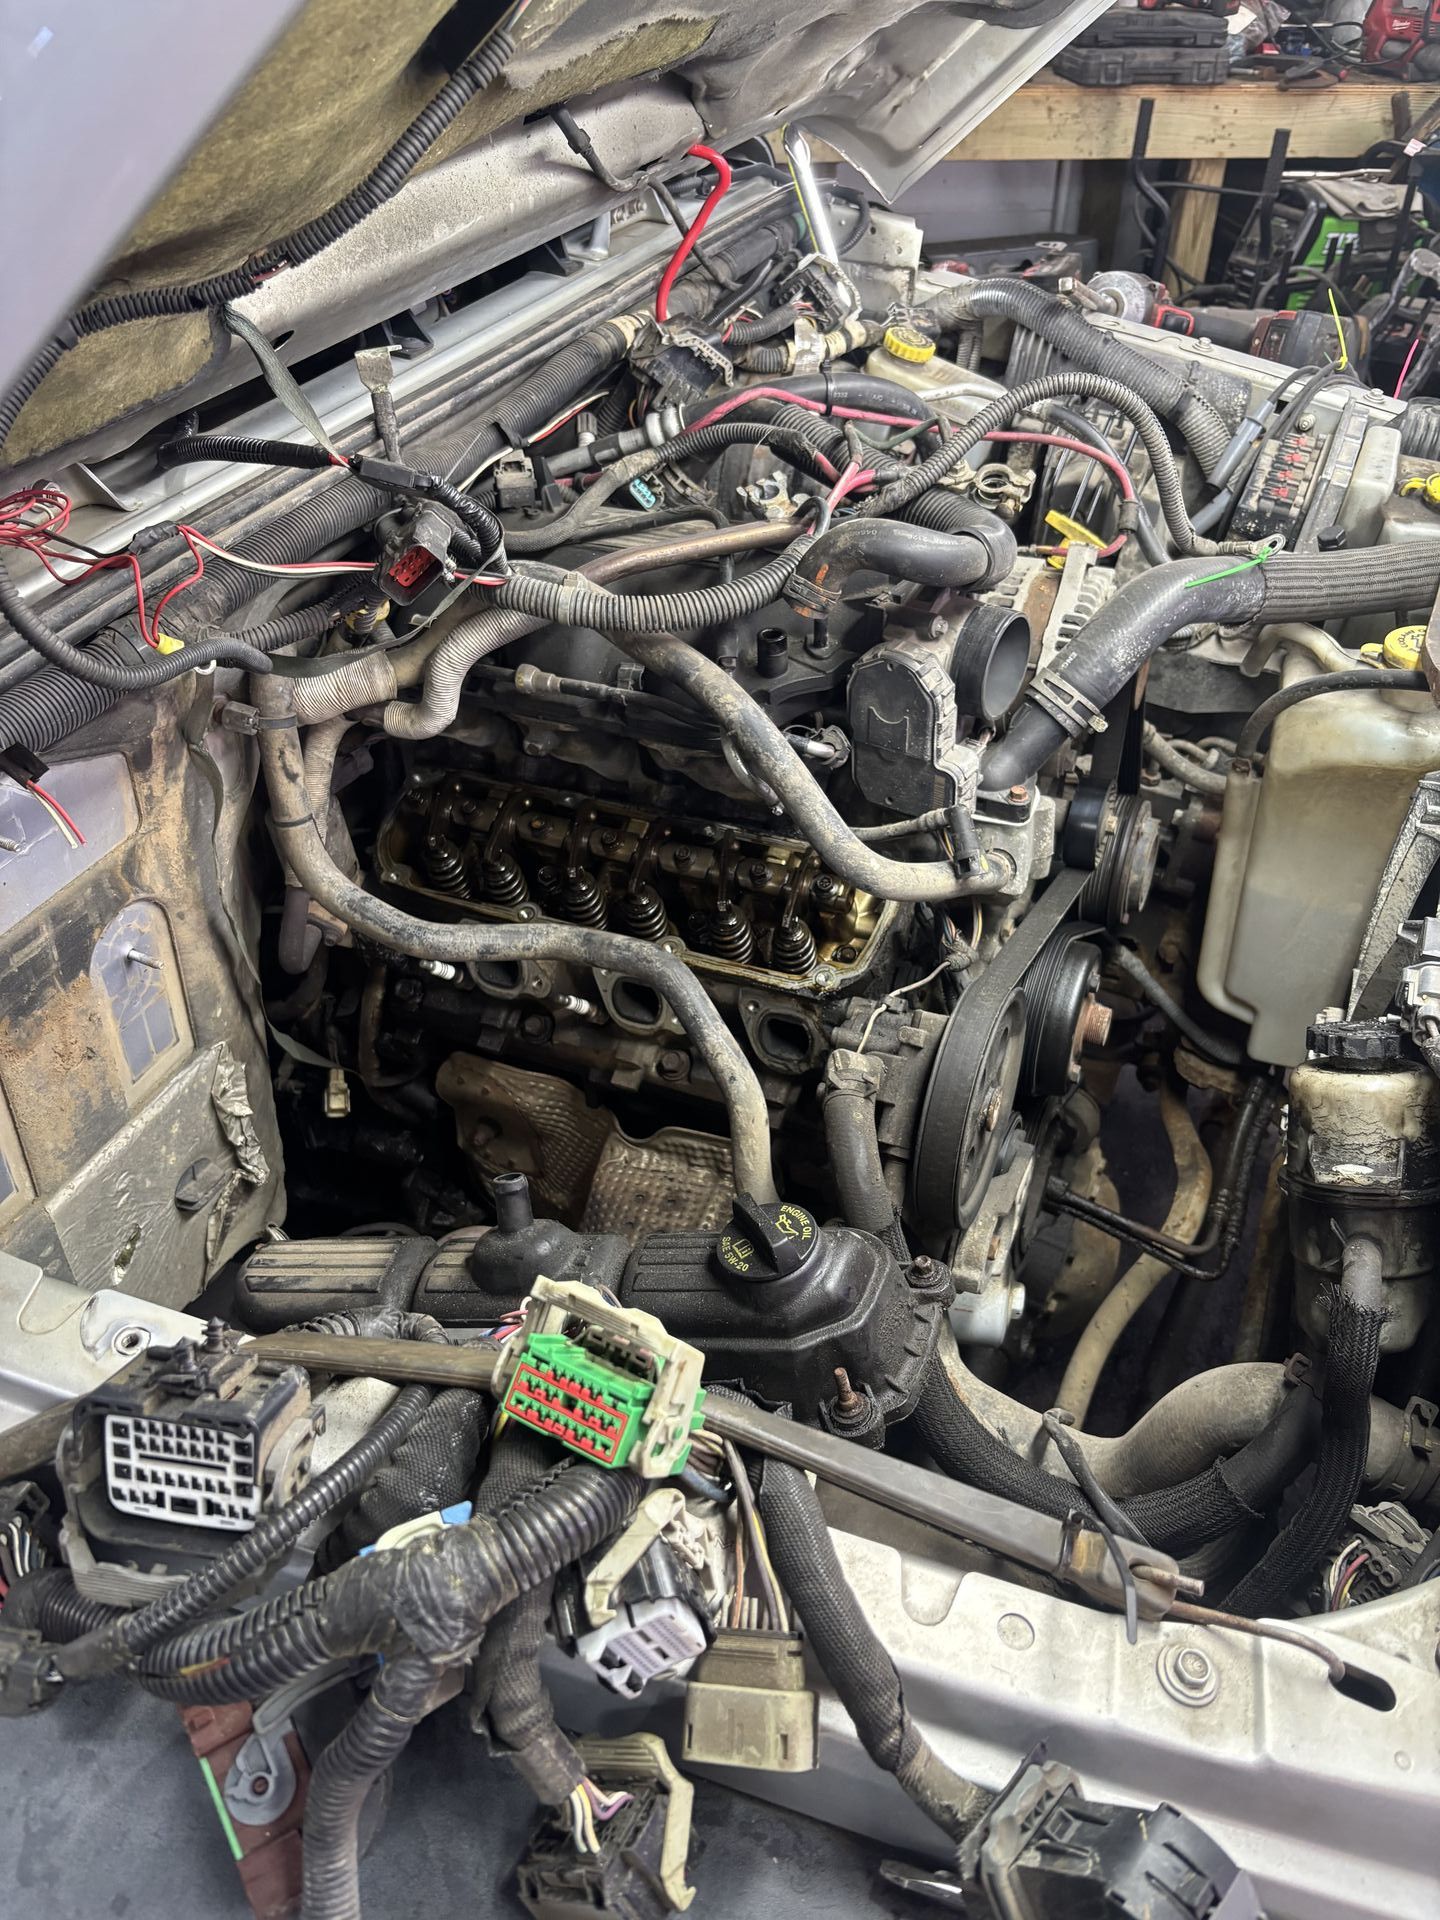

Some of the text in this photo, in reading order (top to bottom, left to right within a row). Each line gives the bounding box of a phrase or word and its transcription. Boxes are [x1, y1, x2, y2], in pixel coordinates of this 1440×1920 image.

[780, 1205, 812, 1241] ENGINE OIL
[722, 1236, 750, 1272] SAE 5W-20
